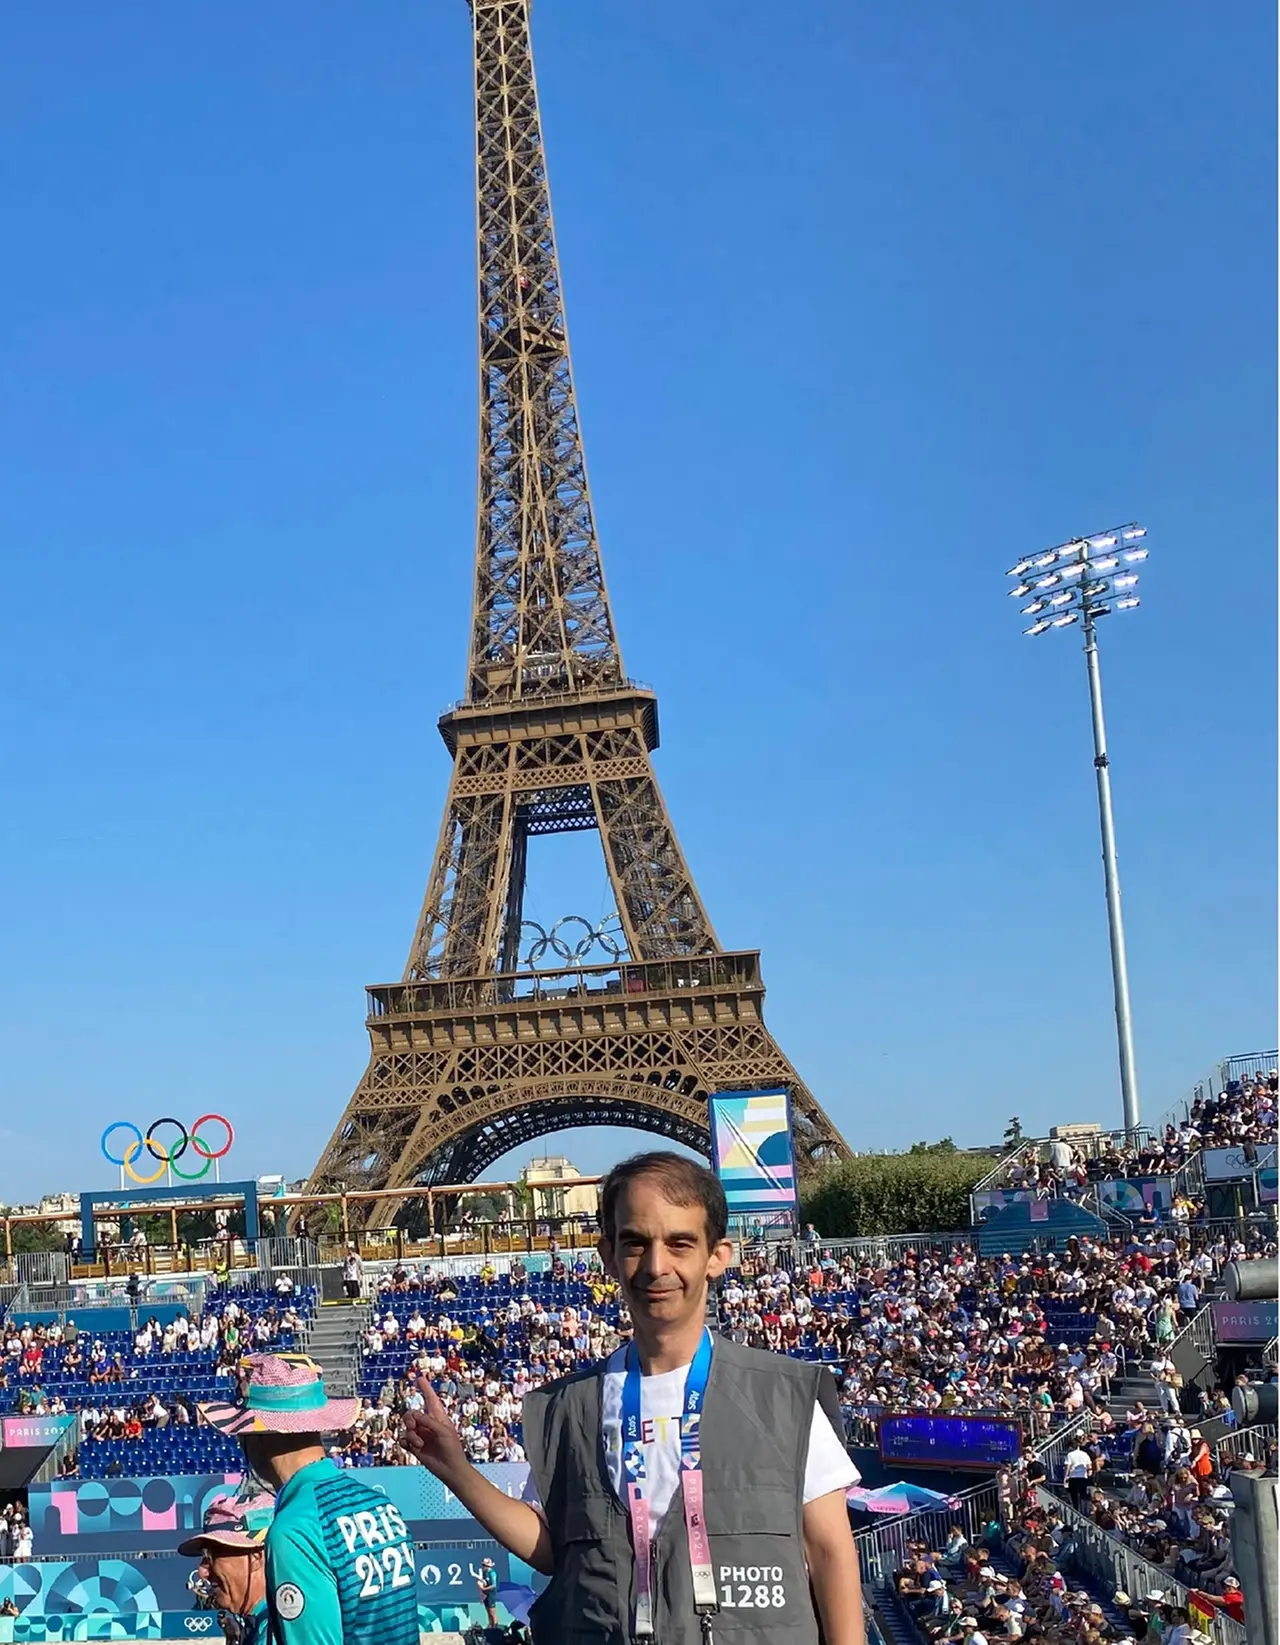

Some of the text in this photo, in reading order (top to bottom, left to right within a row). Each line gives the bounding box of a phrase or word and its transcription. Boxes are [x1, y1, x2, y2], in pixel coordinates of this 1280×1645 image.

[1221, 1315, 1261, 1326] PARIS
[687, 1390, 700, 1410] Atos
[9, 1427, 40, 1437] PARIS
[719, 1565, 784, 1582] PHOTO
[720, 1584, 786, 1609] 1288
